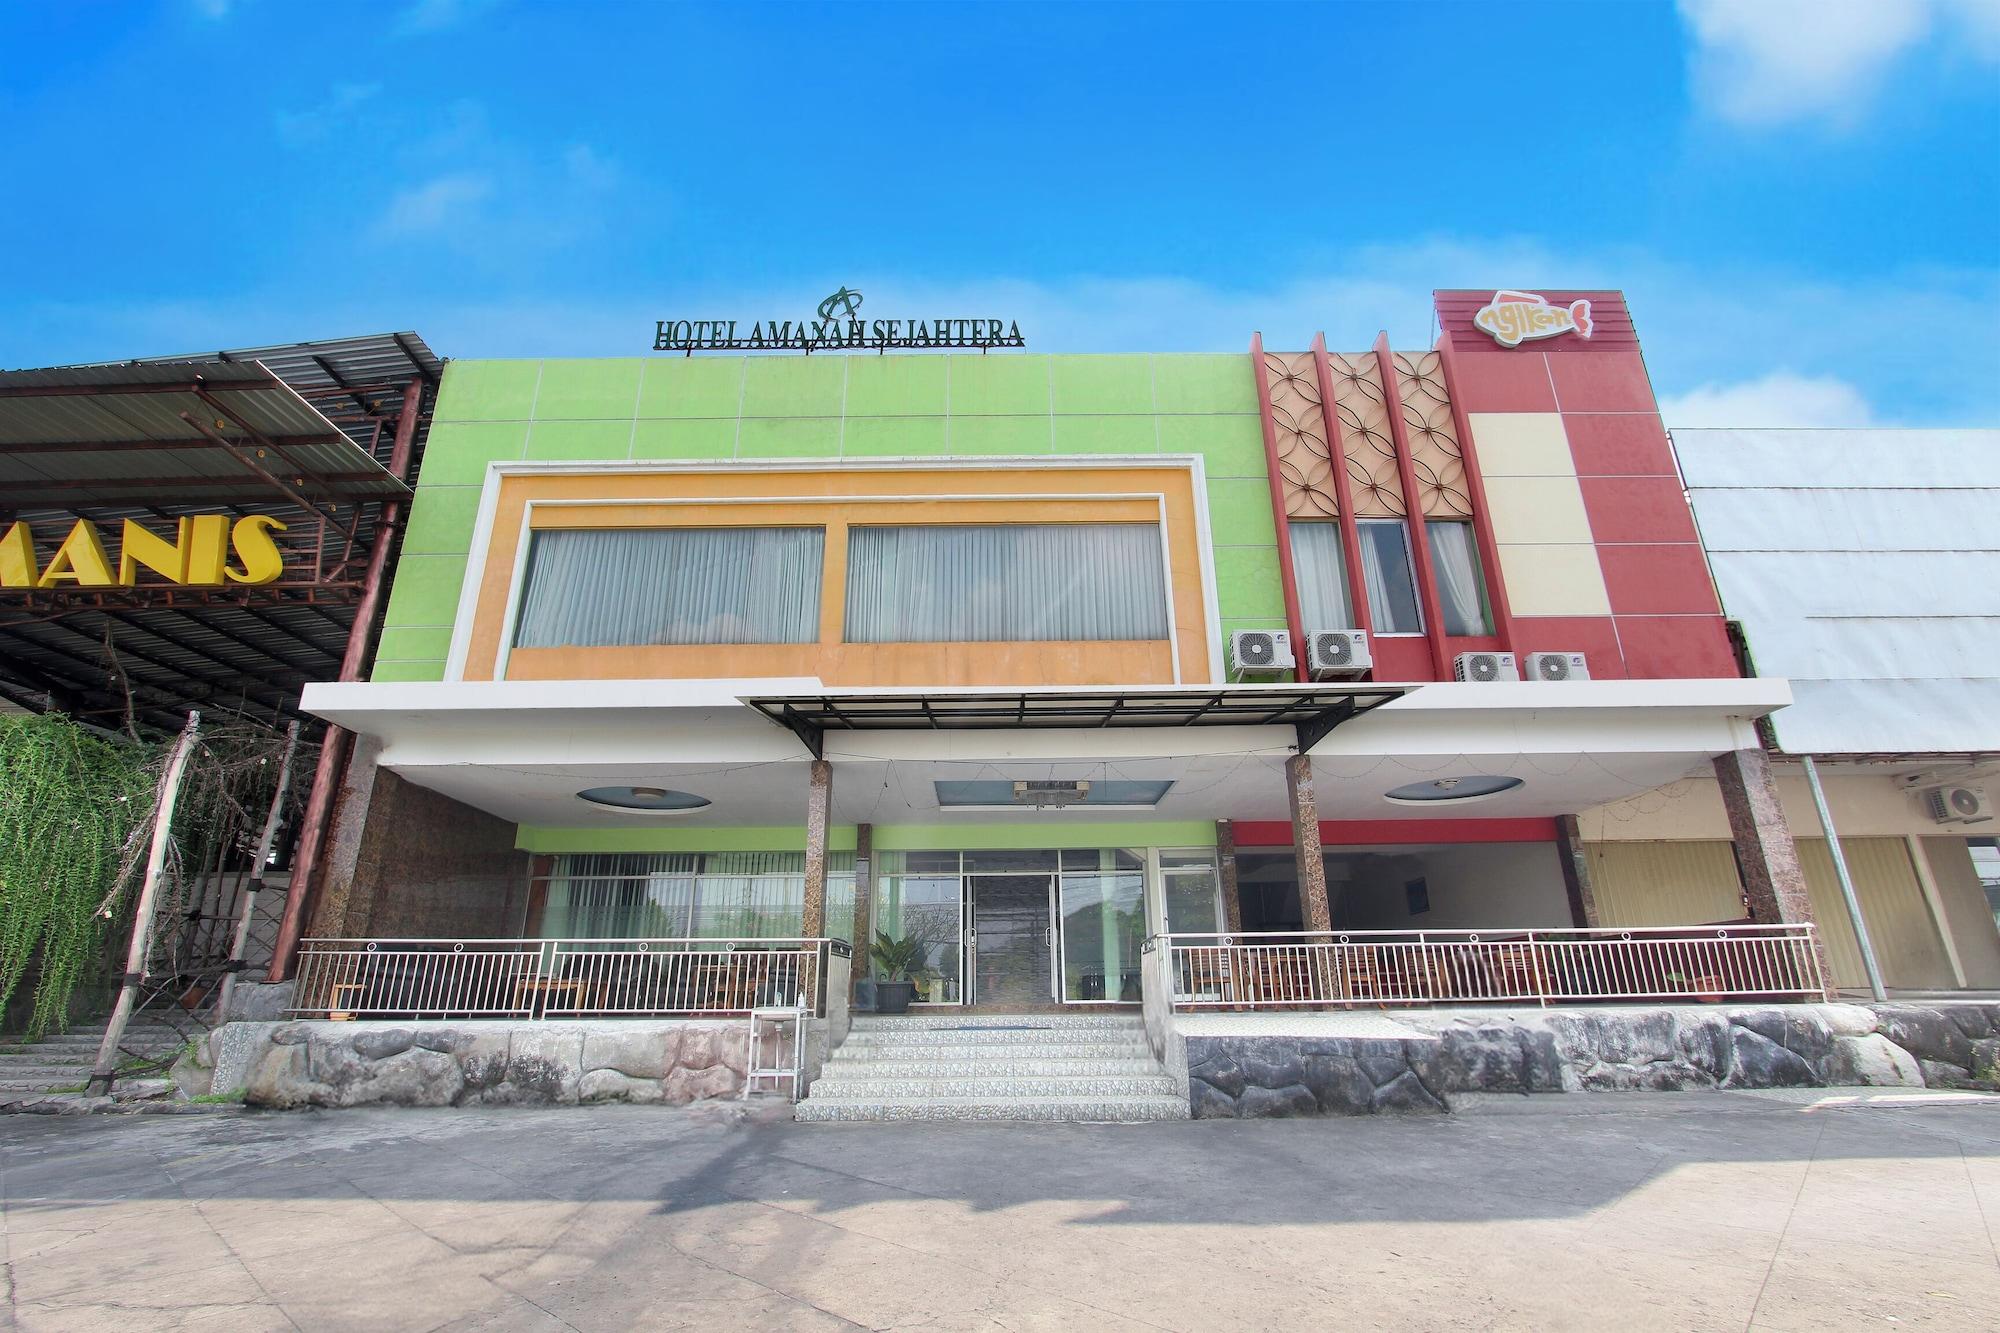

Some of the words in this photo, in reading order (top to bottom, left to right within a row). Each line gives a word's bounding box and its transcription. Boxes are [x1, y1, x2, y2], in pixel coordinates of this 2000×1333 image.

[653, 320, 742, 349] HOTEL
[748, 320, 866, 348] AMANAH
[872, 319, 1025, 347] SEJAHTERA
